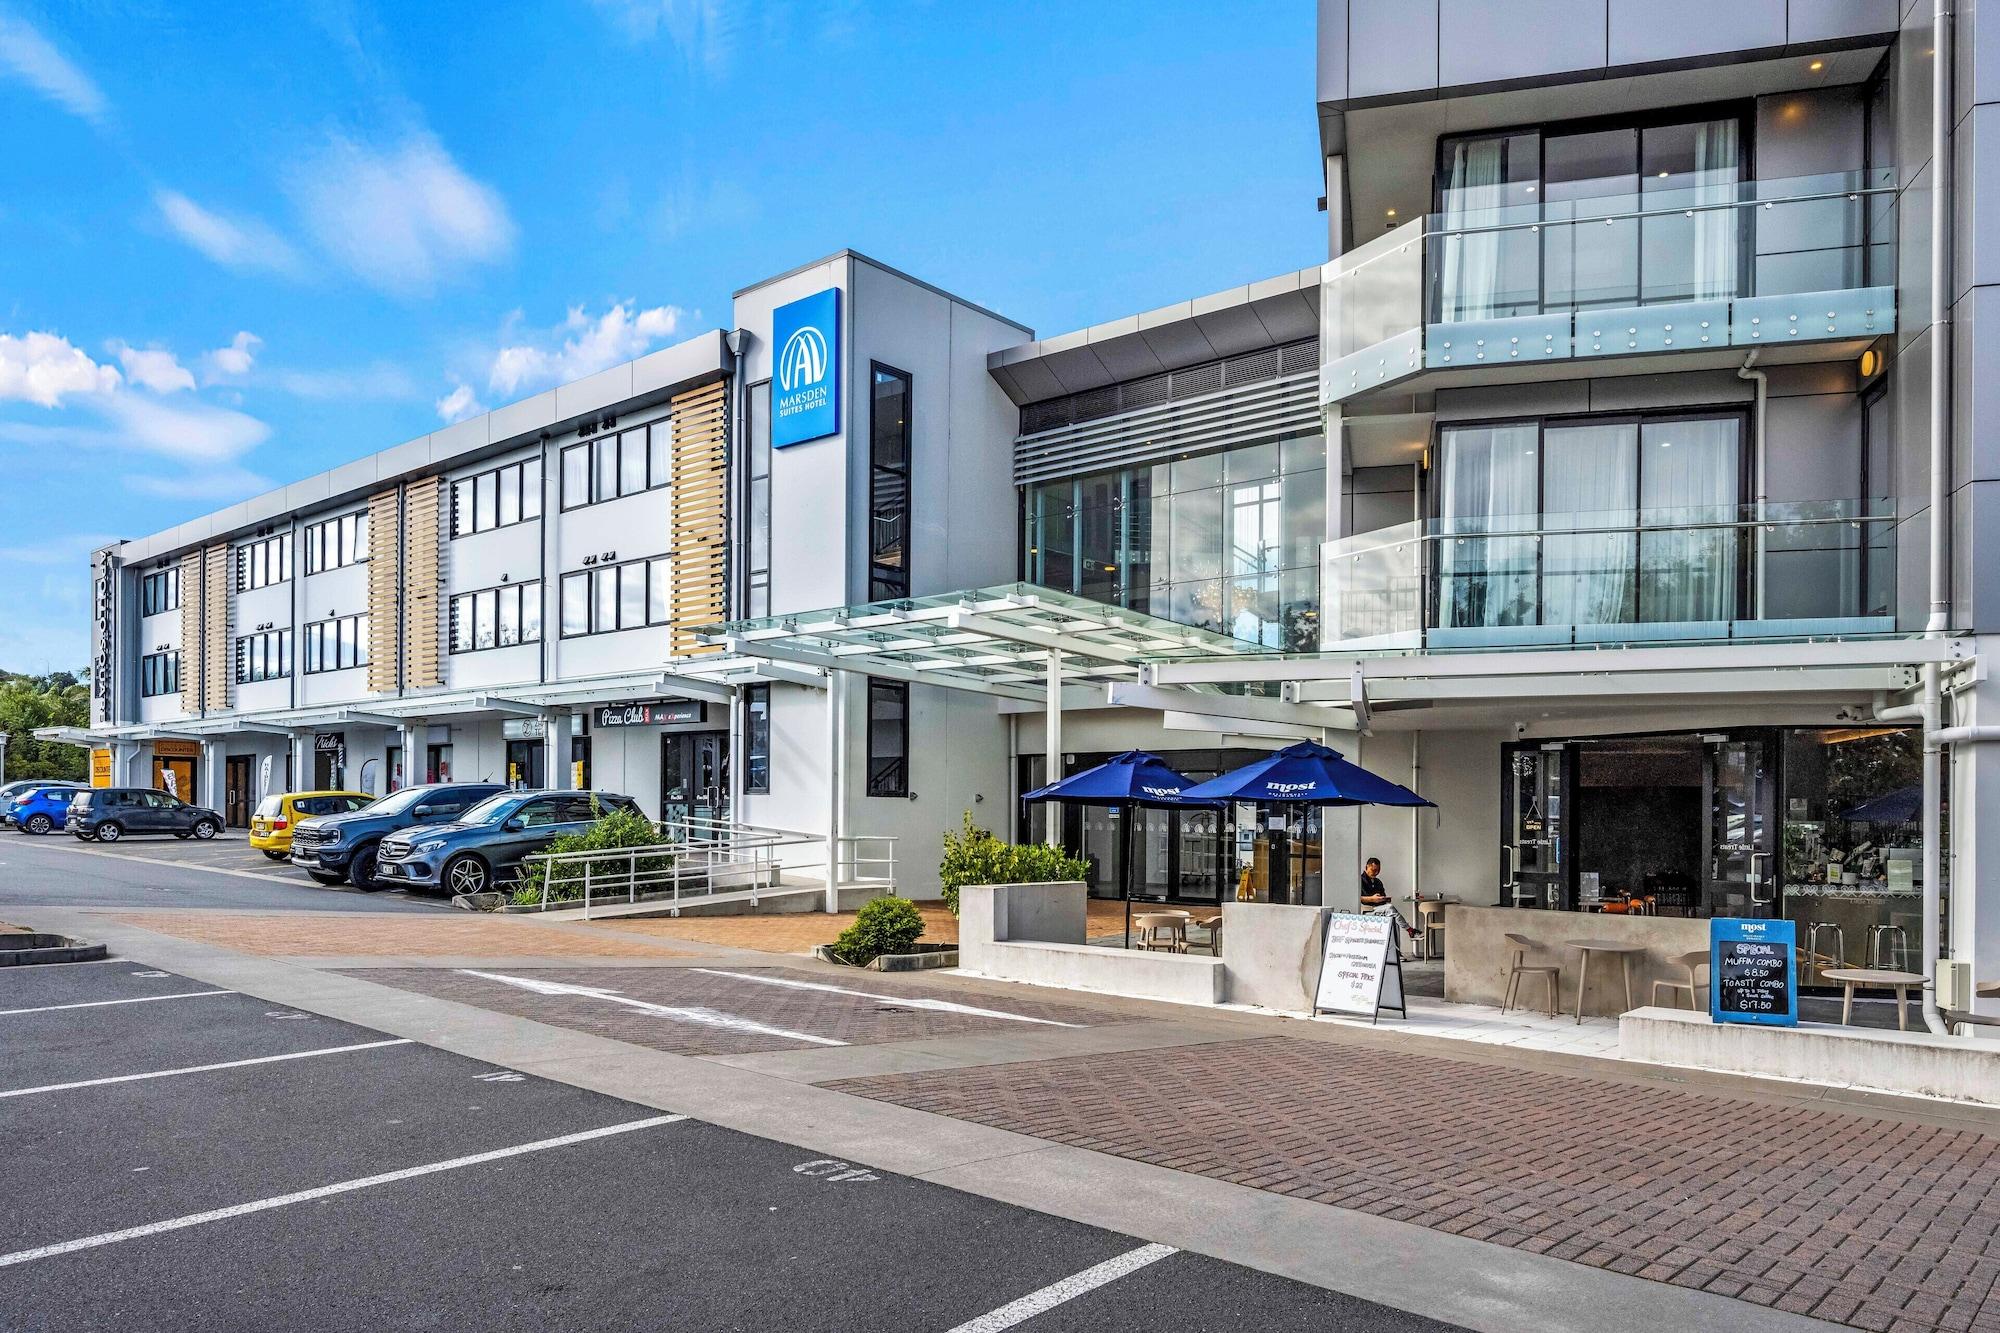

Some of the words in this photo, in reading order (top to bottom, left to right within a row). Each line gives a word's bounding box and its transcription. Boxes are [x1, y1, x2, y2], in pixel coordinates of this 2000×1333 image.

[780, 385, 827, 409] MARSDEN
[780, 405, 803, 418] SUITES
[805, 398, 827, 410] HOTEL
[601, 708, 623, 726] Pizza
[623, 706, 645, 725] Club
[1266, 781, 1317, 793] most
[1741, 923, 1767, 933] most
[1736, 943, 1774, 955] SPECIAL
[1724, 957, 1755, 966] MUFFIN
[1756, 958, 1783, 967] COMBO
[1337, 970, 1359, 980] SPECIAL
[1759, 979, 1784, 989] COMBO
[1739, 999, 1772, 1011] $17.50
